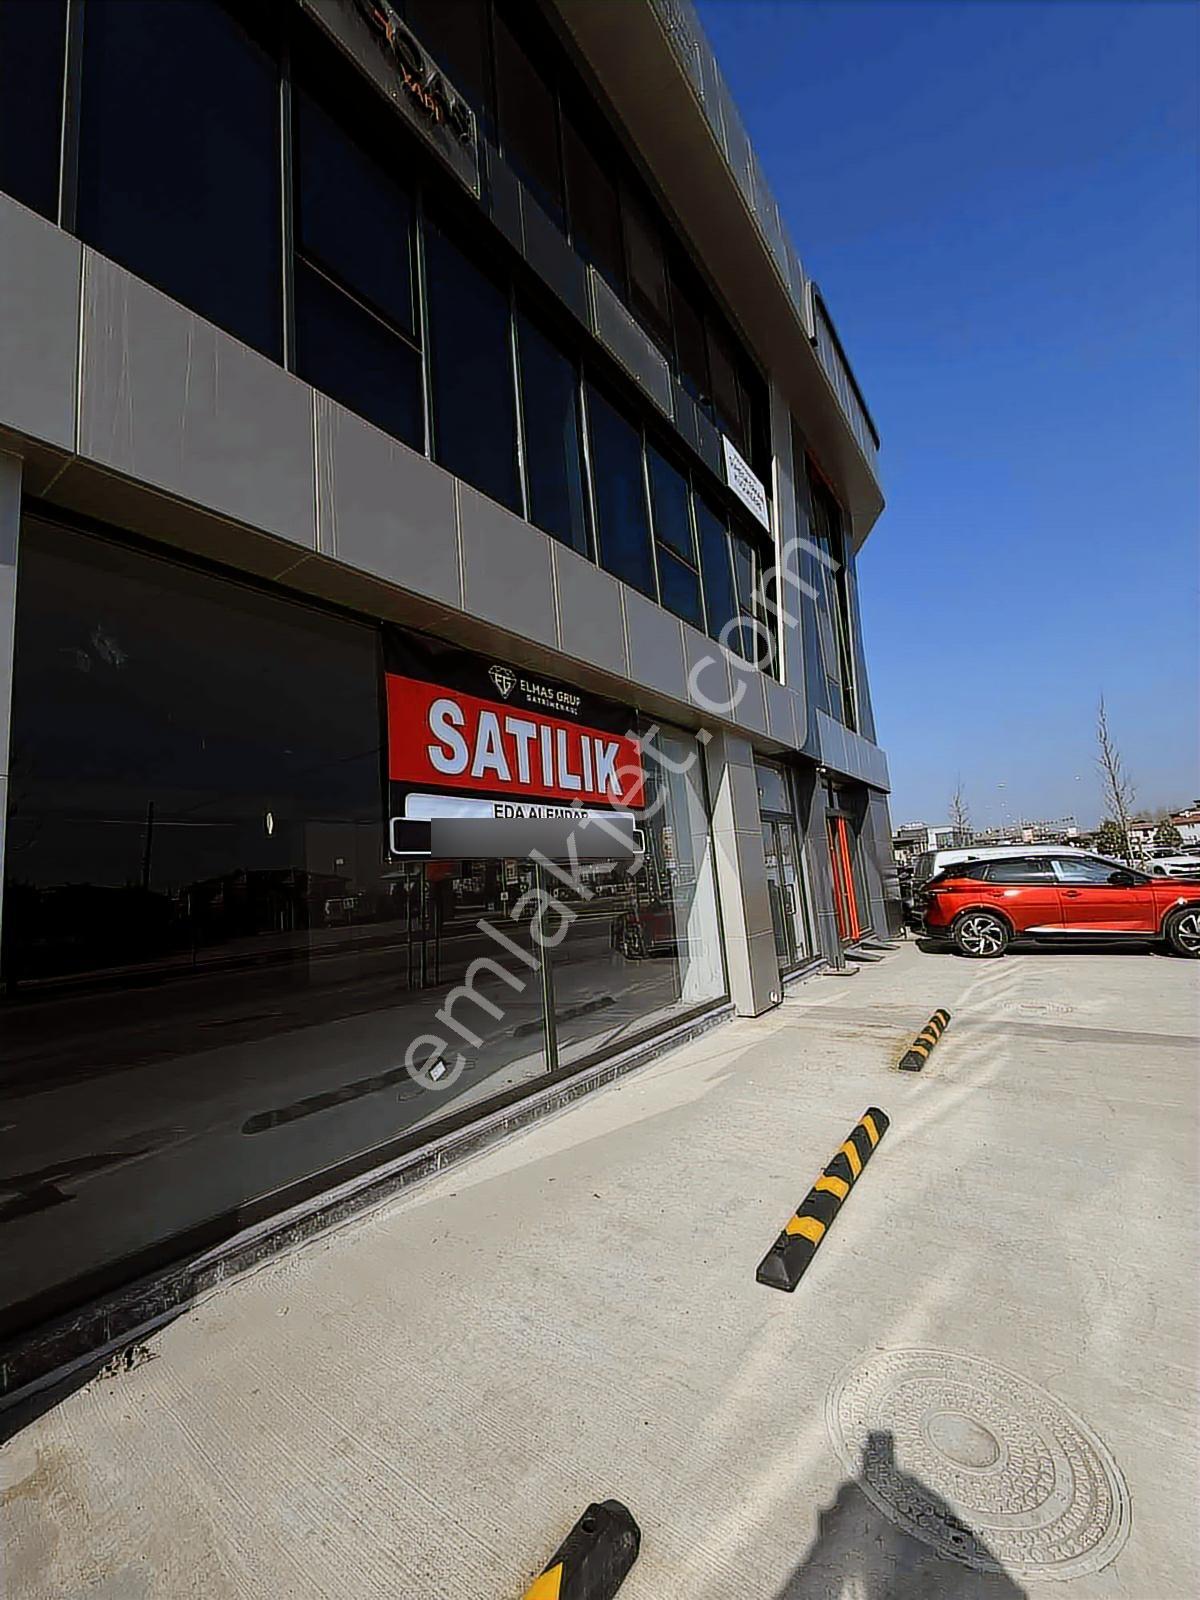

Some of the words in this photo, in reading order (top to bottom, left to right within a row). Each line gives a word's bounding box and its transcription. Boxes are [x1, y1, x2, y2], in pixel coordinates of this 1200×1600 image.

[520, 679, 554, 699] ELMAS
[427, 697, 624, 797] SATILIK
[494, 803, 524, 819] EDA
